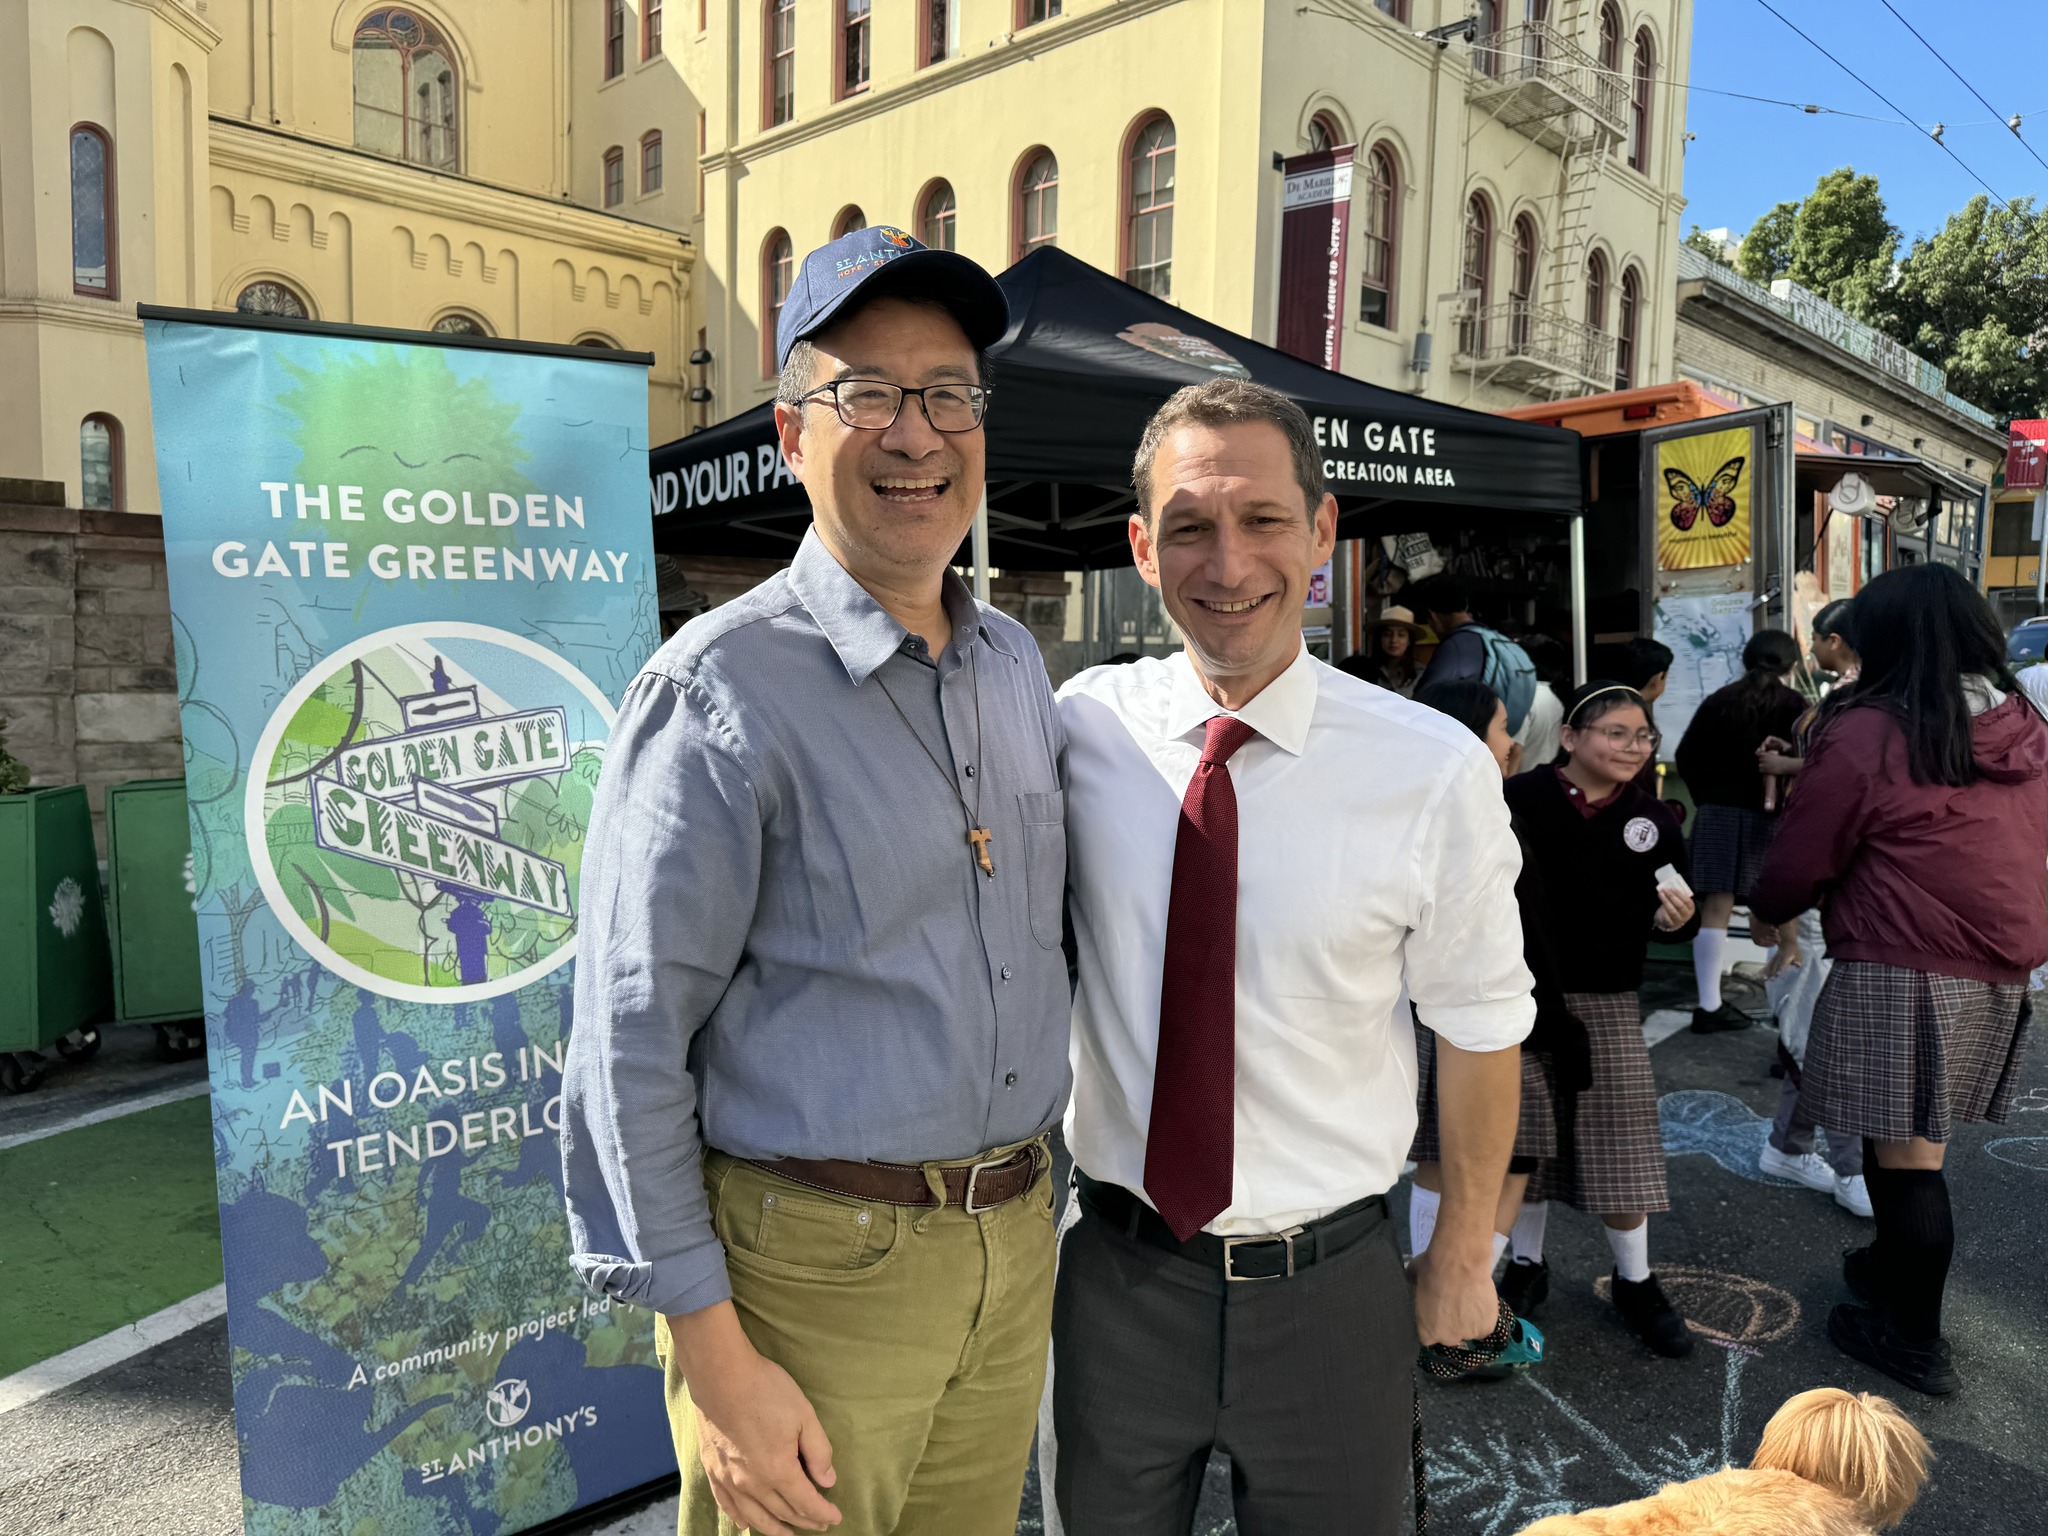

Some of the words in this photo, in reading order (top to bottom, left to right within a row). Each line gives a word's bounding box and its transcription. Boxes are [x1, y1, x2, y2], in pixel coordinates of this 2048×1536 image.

[1327, 217, 1342, 256] Serve
[1364, 421, 1436, 457] GATE
[260, 481, 366, 522] THE
[382, 489, 586, 529] GOLDEN
[681, 451, 750, 509] YOUR
[757, 444, 802, 493] PA
[1323, 459, 1408, 484] CREATION
[1414, 467, 1455, 487] AREA
[212, 541, 351, 578] GATE
[368, 546, 629, 583] GREENWAY
[346, 736, 462, 793] GOLDEN
[474, 716, 559, 771] GATE
[326, 788, 560, 908] GREENWAY
[280, 1079, 353, 1129] AN
[369, 1052, 507, 1109] OASIS
[520, 1041, 564, 1081] IN
[348, 1364, 367, 1390] A
[375, 1330, 500, 1381] community
[505, 1307, 577, 1350] project
[583, 1294, 610, 1320] led
[421, 1458, 444, 1477] ST.
[448, 1406, 598, 1475] ANTHONY'S
